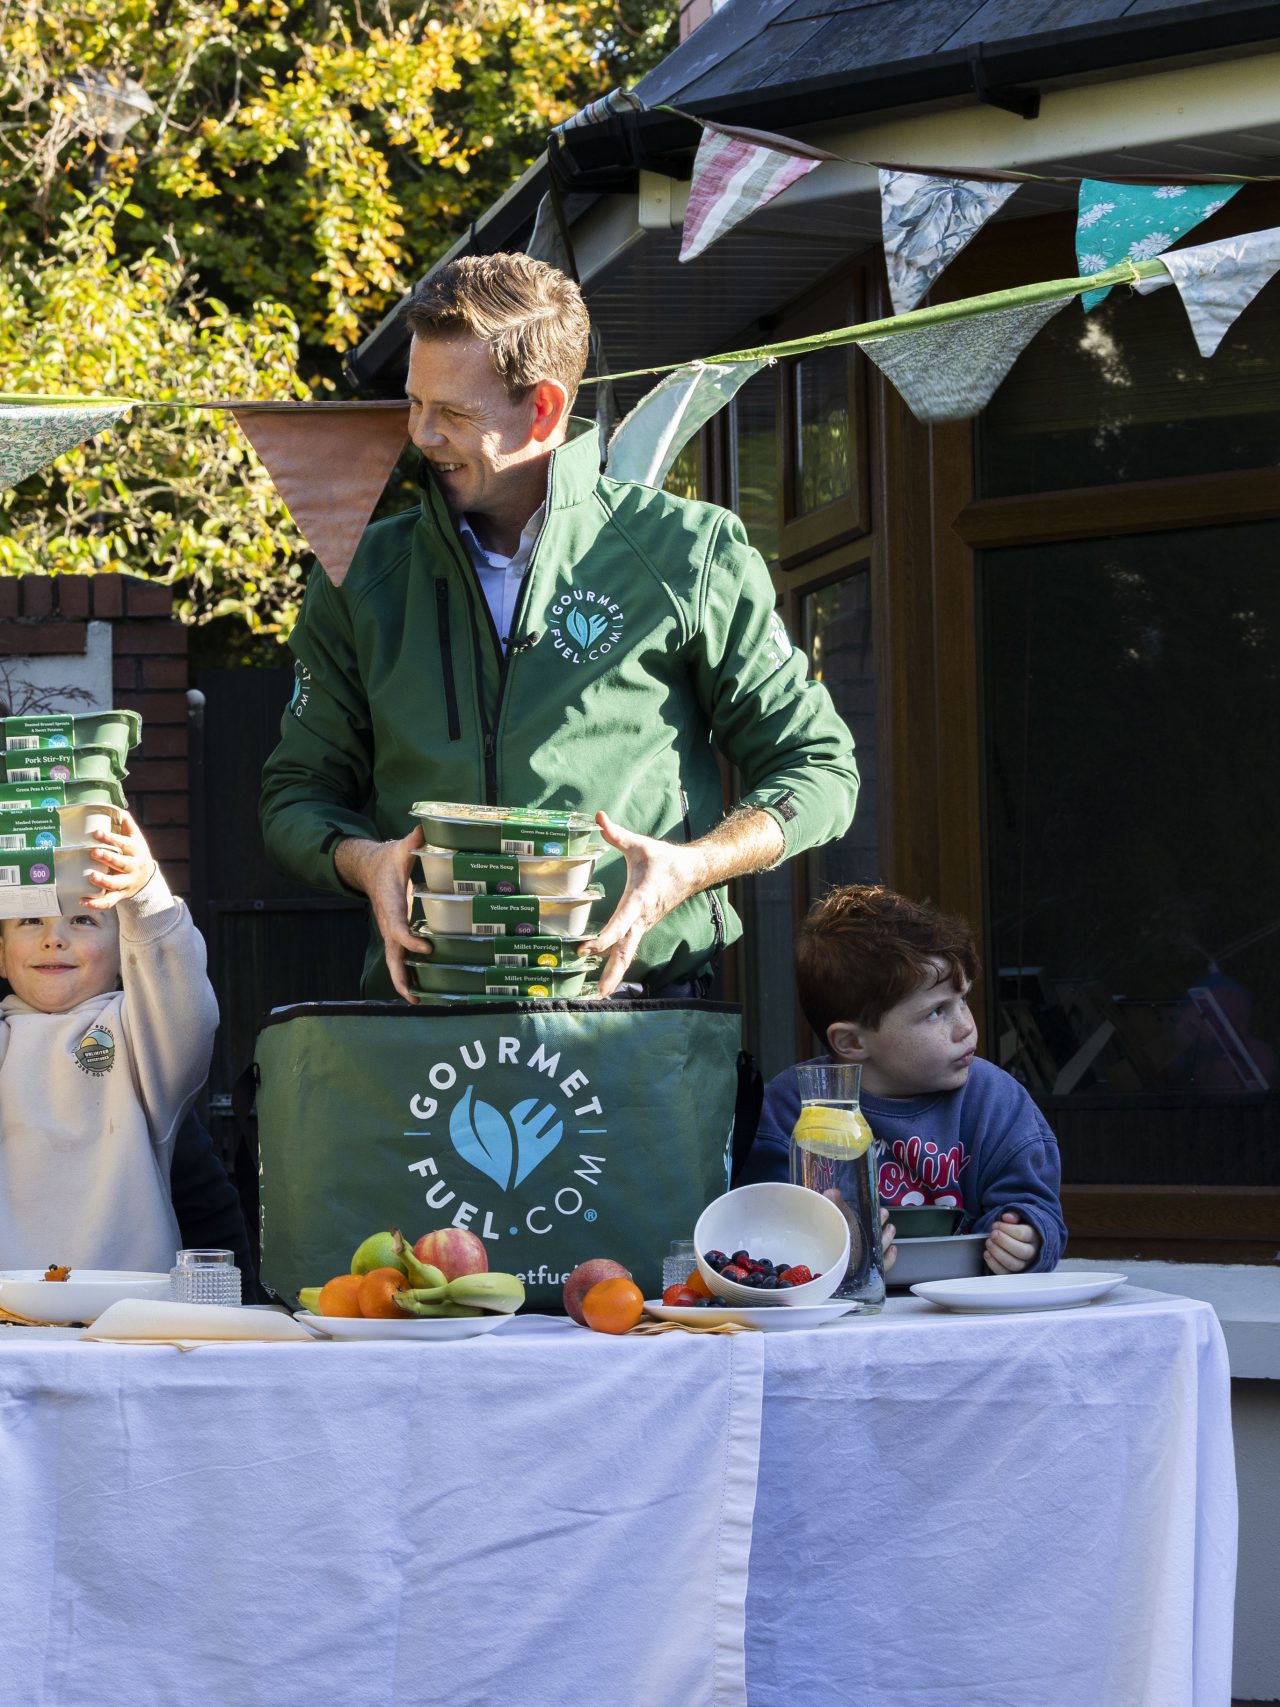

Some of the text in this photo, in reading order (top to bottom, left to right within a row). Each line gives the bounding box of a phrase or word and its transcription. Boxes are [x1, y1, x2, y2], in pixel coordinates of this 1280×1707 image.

[552, 590, 624, 620] GOURMET
[24, 754, 71, 764] Pork Stir-Fry
[32, 870, 46, 878] 500
[532, 944, 559, 952] Porridge
[523, 975, 550, 983] Porridge
[409, 1036, 603, 1120] GOURMET
